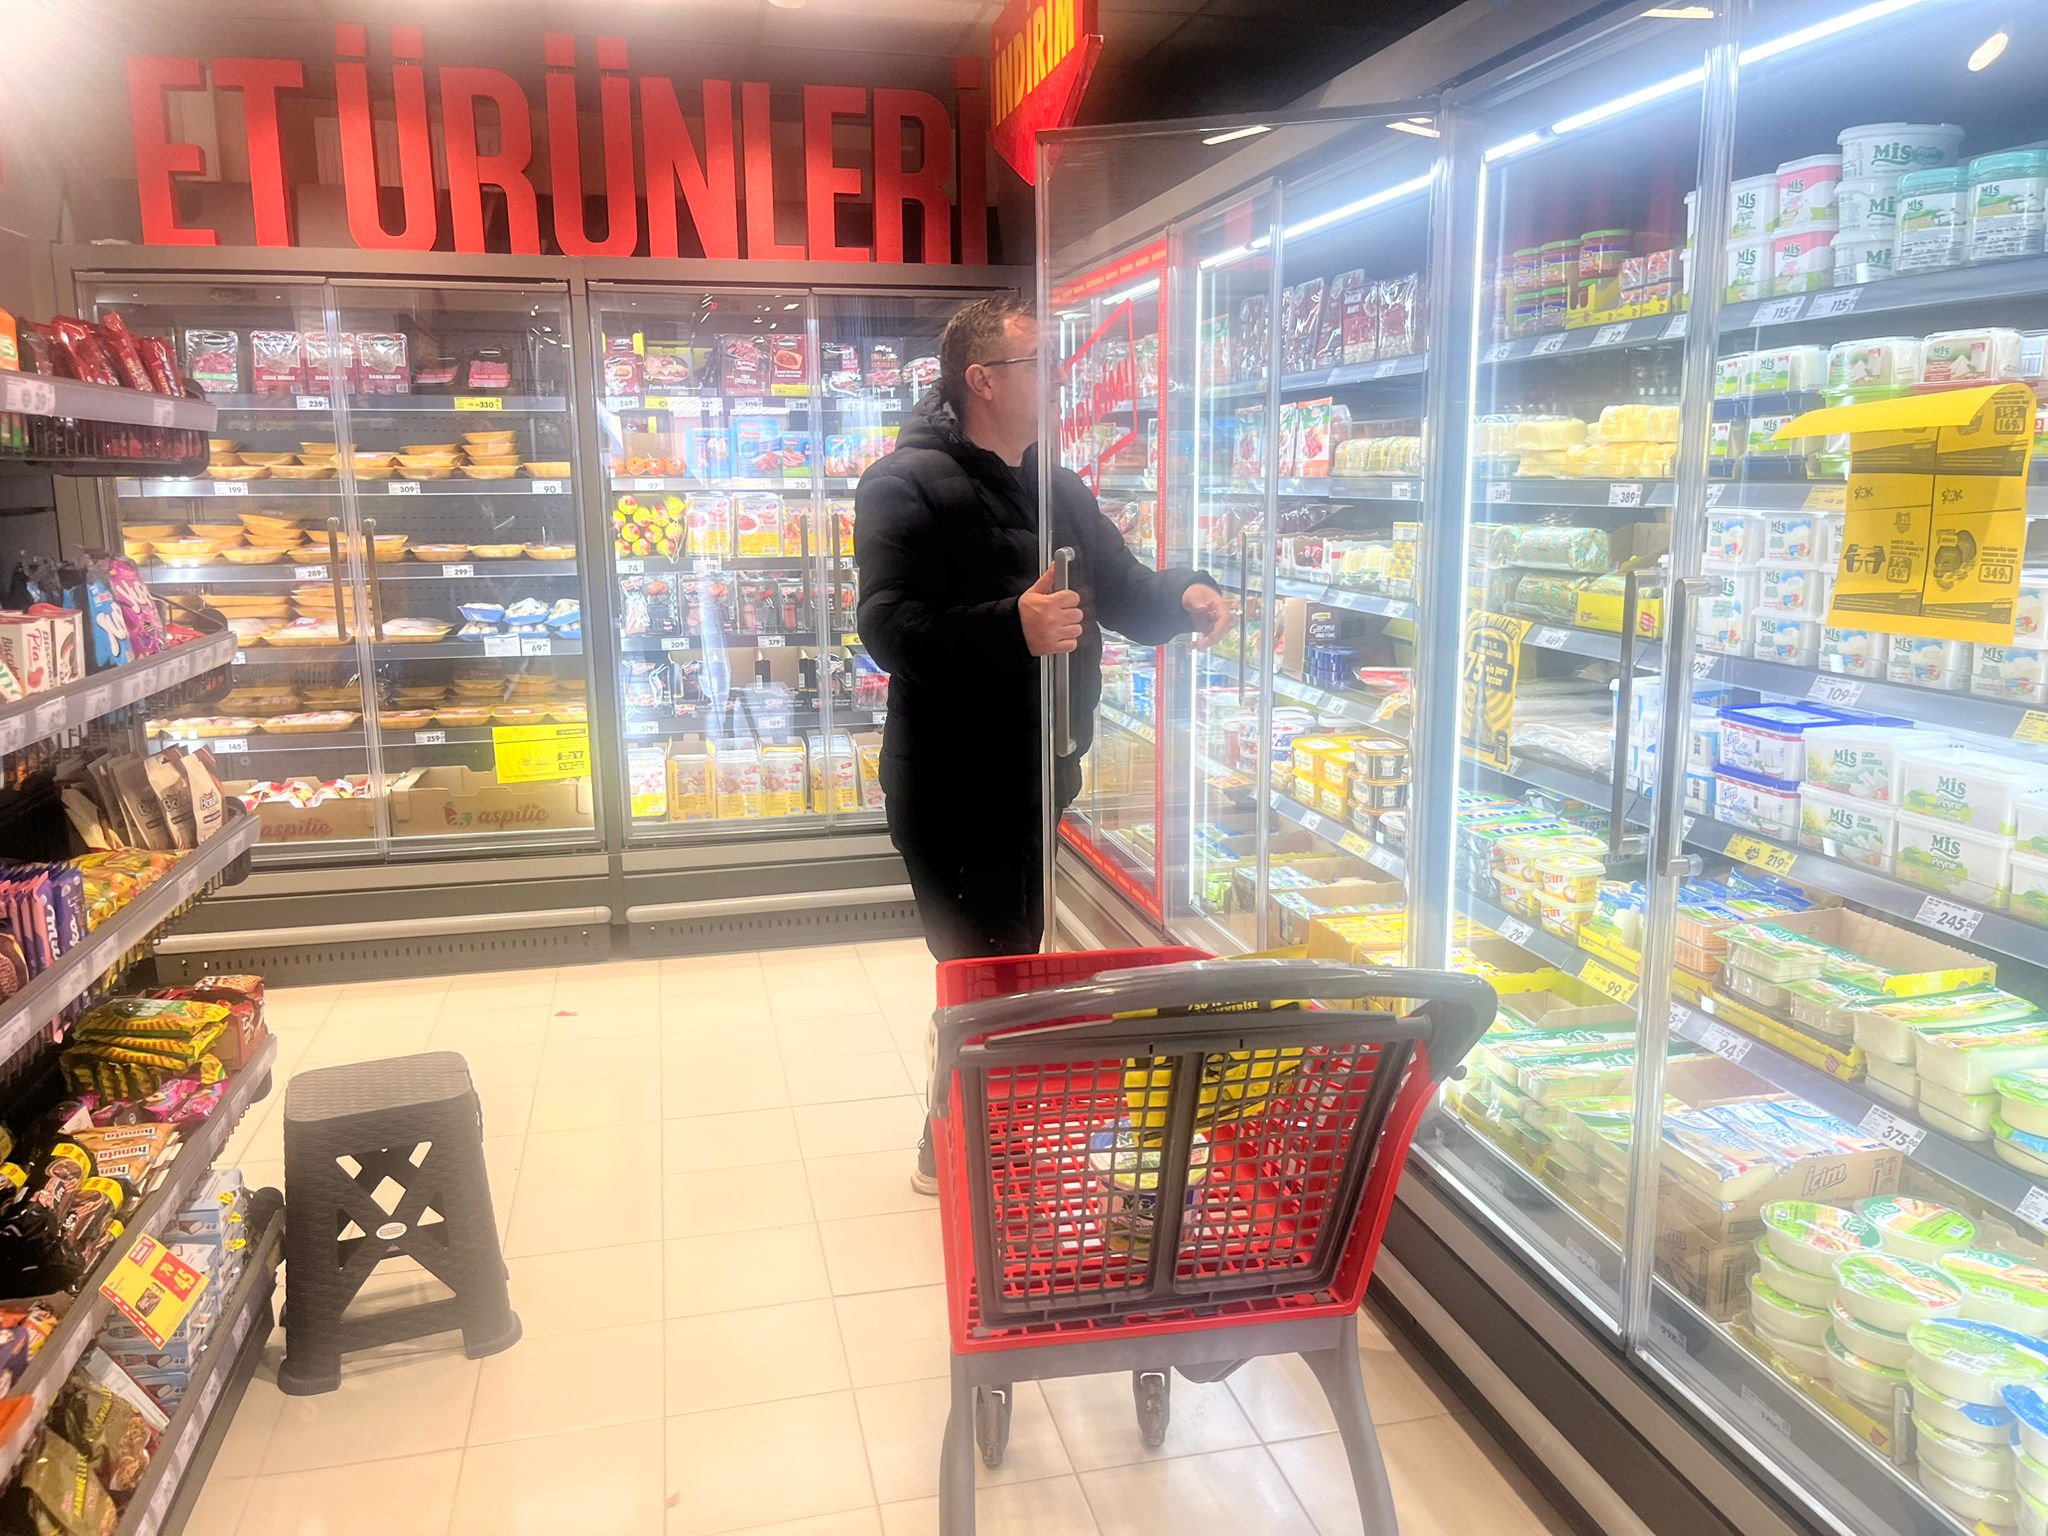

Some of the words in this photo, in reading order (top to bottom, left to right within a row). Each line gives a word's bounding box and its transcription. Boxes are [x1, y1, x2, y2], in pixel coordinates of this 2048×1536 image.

[126, 56, 303, 247] ET
[333, 22, 990, 265] ÜRÜNLERİ
[308, 400, 324, 408] 239
[479, 401, 495, 409] 330
[543, 485, 557, 493] 90
[794, 481, 807, 489] 20
[1620, 491, 1635, 503] 389
[454, 568, 469, 576] 299
[530, 644, 543, 652] 69
[1827, 688, 1850, 701] 109
[425, 735, 441, 743] 259
[1765, 854, 1785, 868] 219
[1510, 928, 1524, 941] 29
[1605, 981, 1622, 996] 99
[1716, 1039, 1737, 1058] 94
[100, 1145, 148, 1159] hanuta
